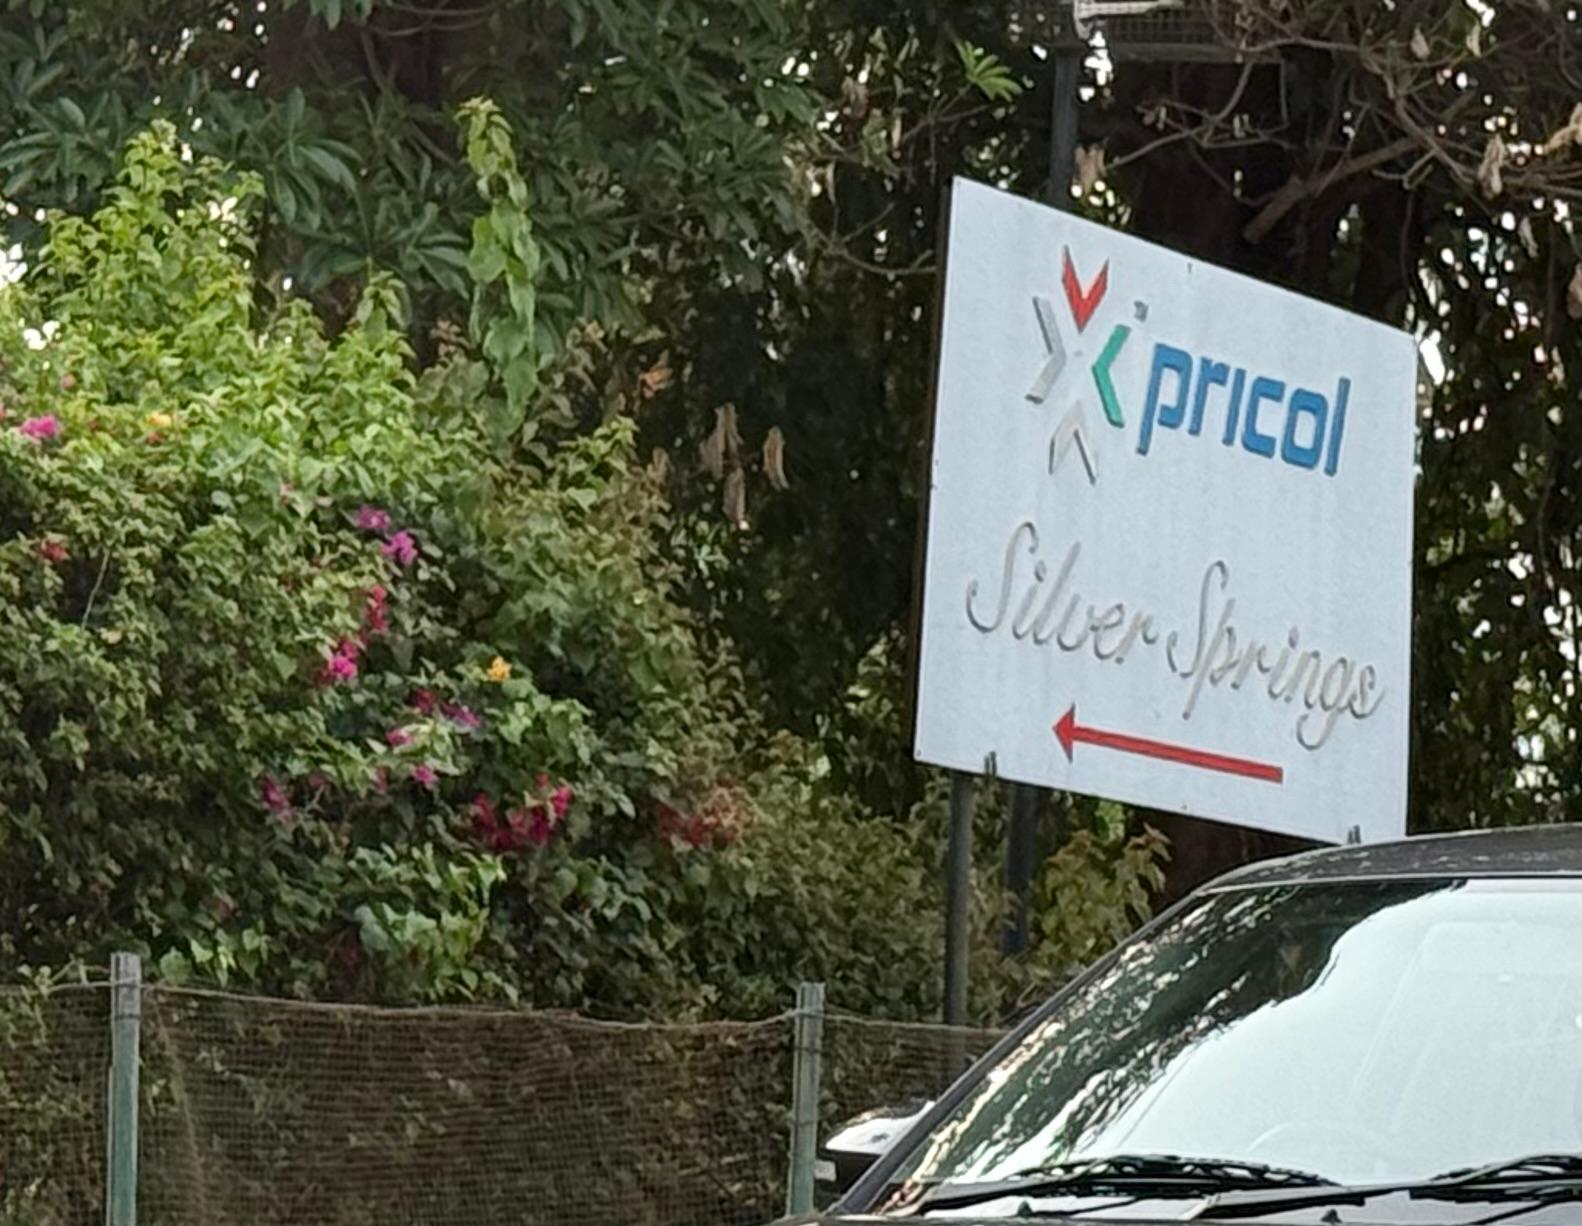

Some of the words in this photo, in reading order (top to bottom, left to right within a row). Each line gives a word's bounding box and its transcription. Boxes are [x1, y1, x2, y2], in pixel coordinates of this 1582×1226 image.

[1137, 342, 1352, 477] pricol
[966, 520, 1159, 665] Silver
[1166, 559, 1385, 751] Springs
